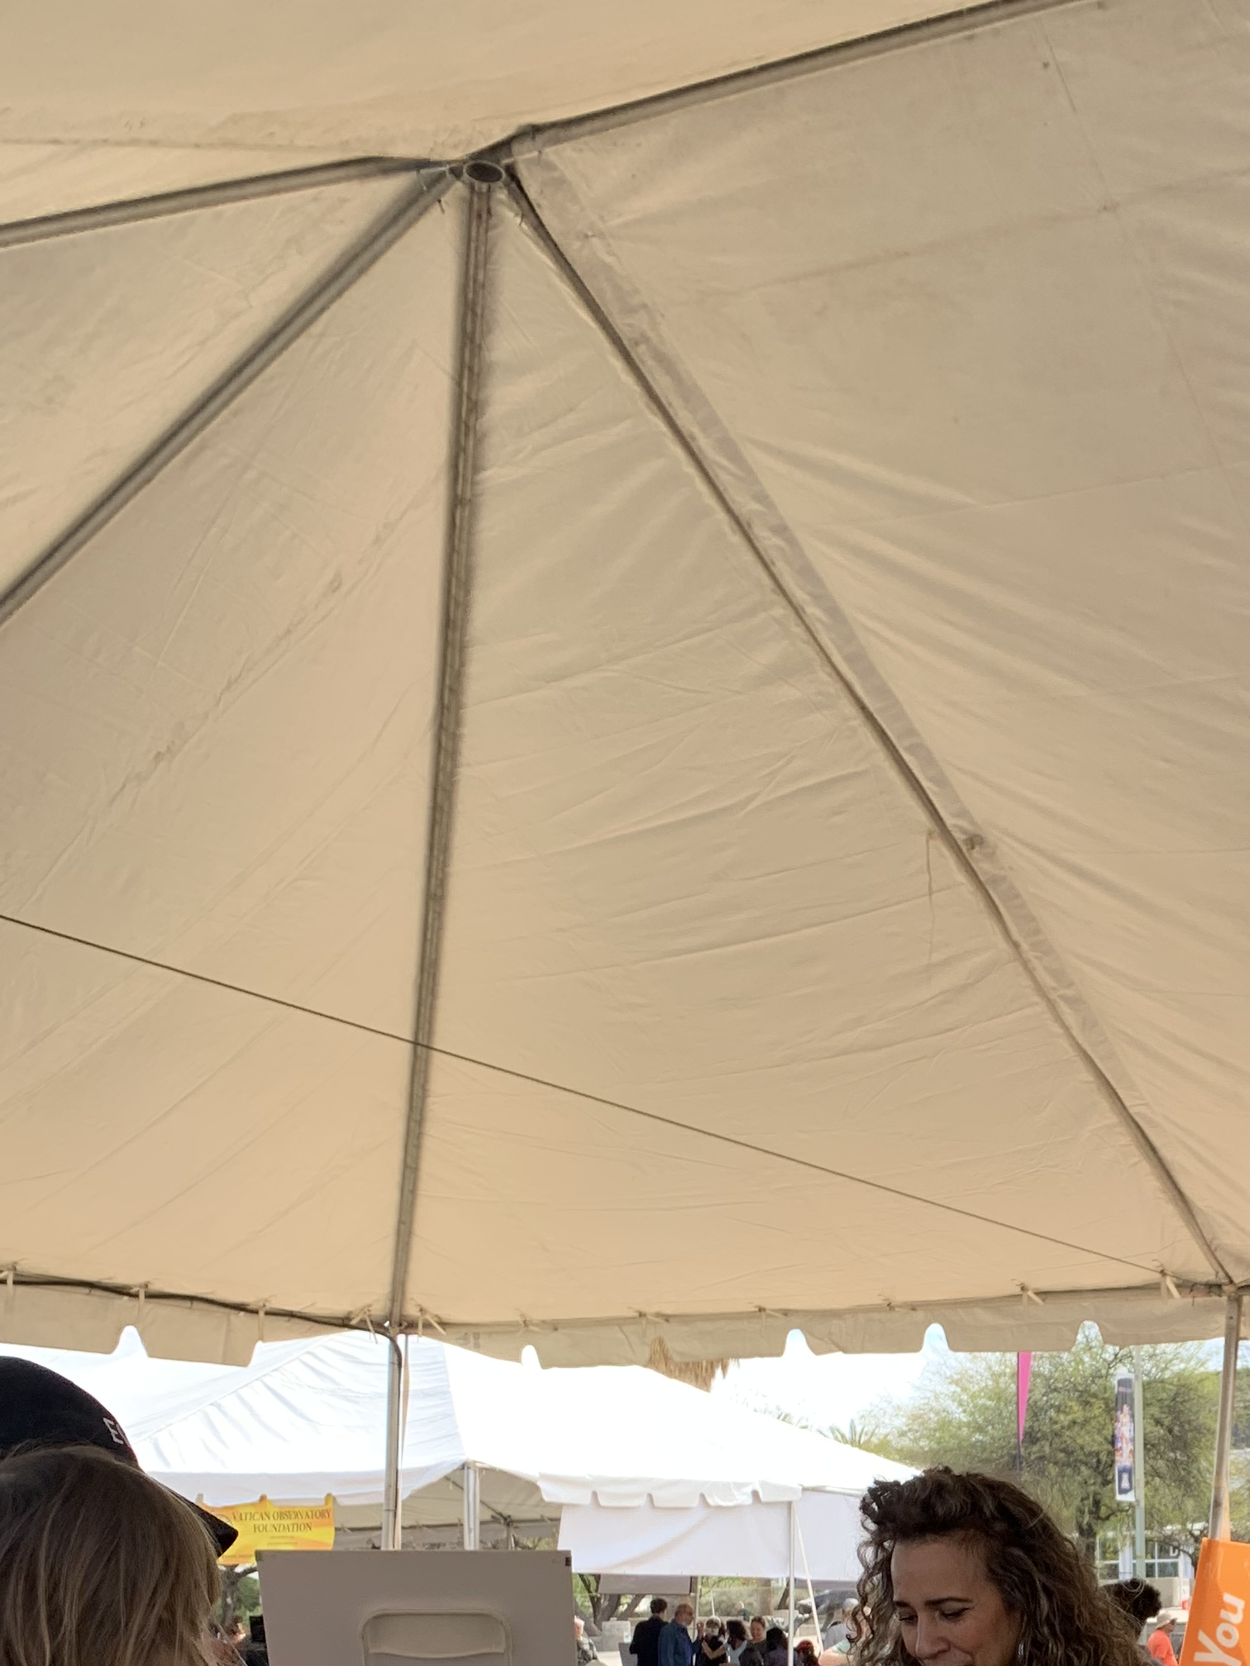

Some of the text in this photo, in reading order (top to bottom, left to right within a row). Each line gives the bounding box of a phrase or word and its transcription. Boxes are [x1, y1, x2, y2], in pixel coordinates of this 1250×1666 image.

[232, 1508, 331, 1521] VATICAN OBSERVATORY
[253, 1522, 312, 1533] FOUNDATION
